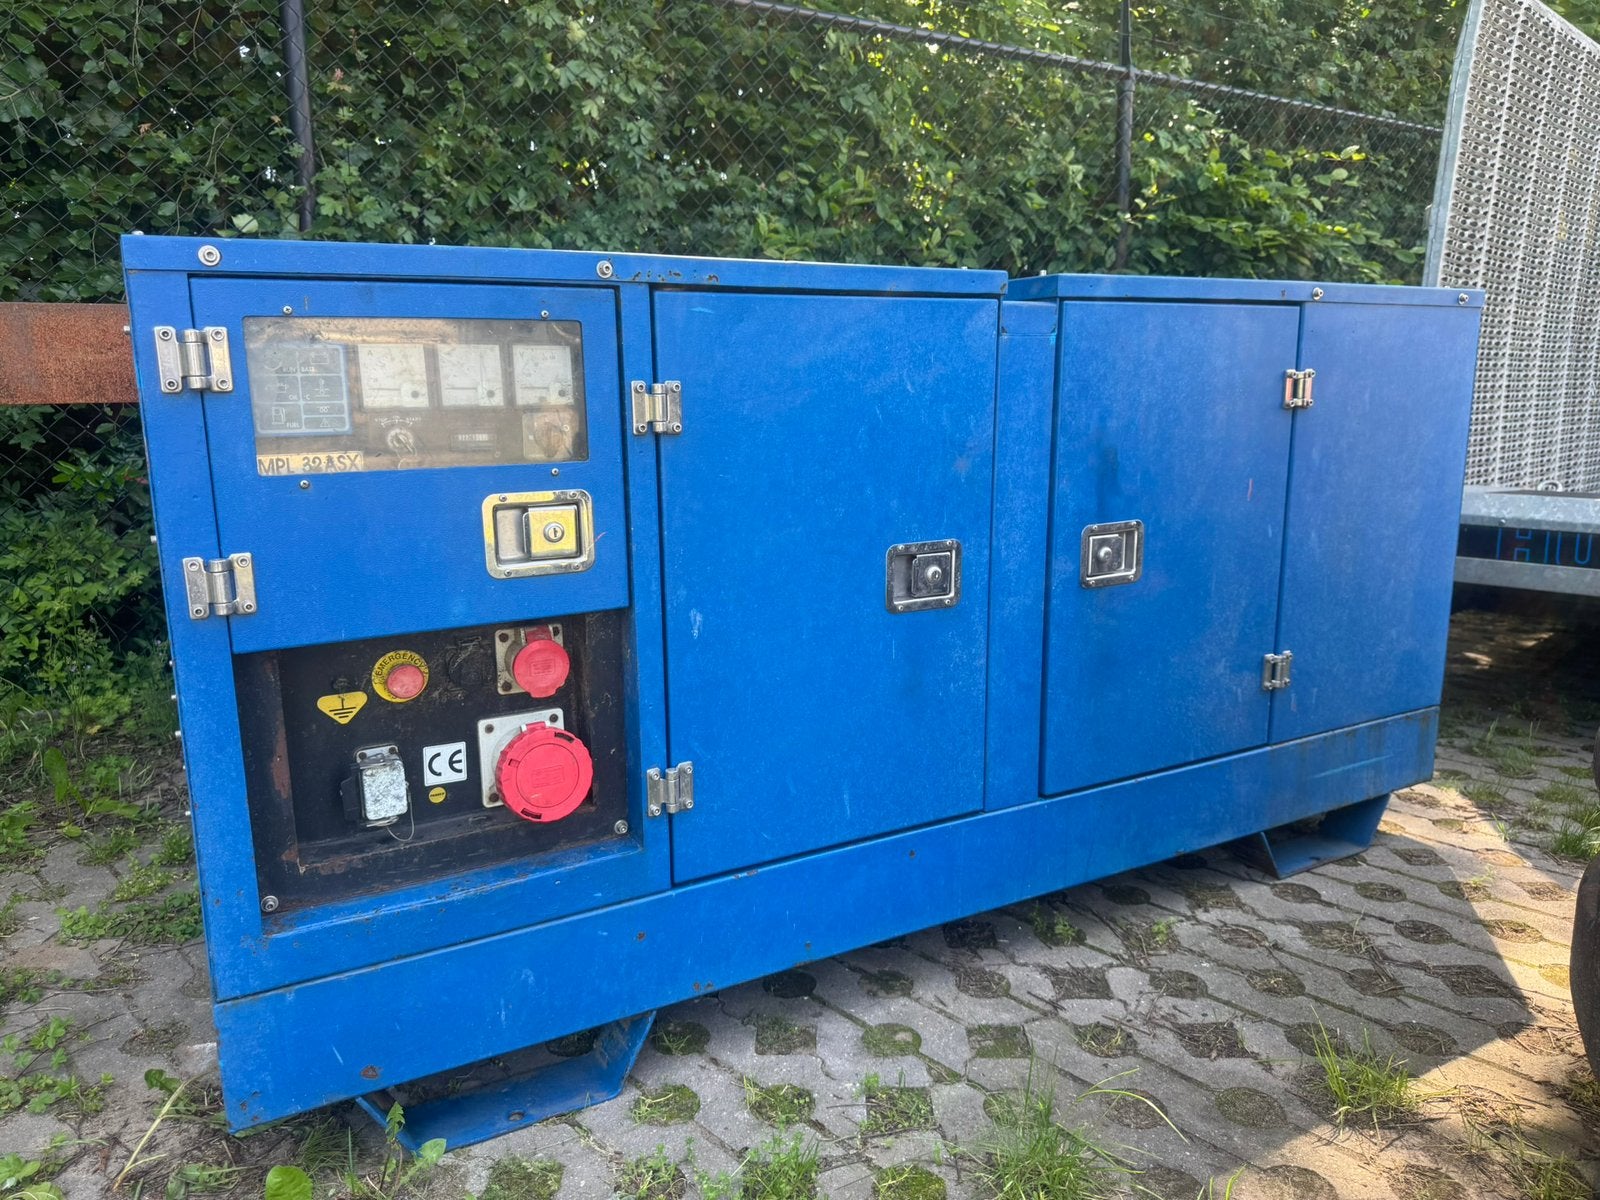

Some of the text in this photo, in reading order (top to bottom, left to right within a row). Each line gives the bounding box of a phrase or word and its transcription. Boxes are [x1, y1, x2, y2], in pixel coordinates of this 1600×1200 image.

[258, 457, 295, 475] MPL
[374, 652, 425, 676] EMERGENCY
[428, 749, 463, 777] CE
